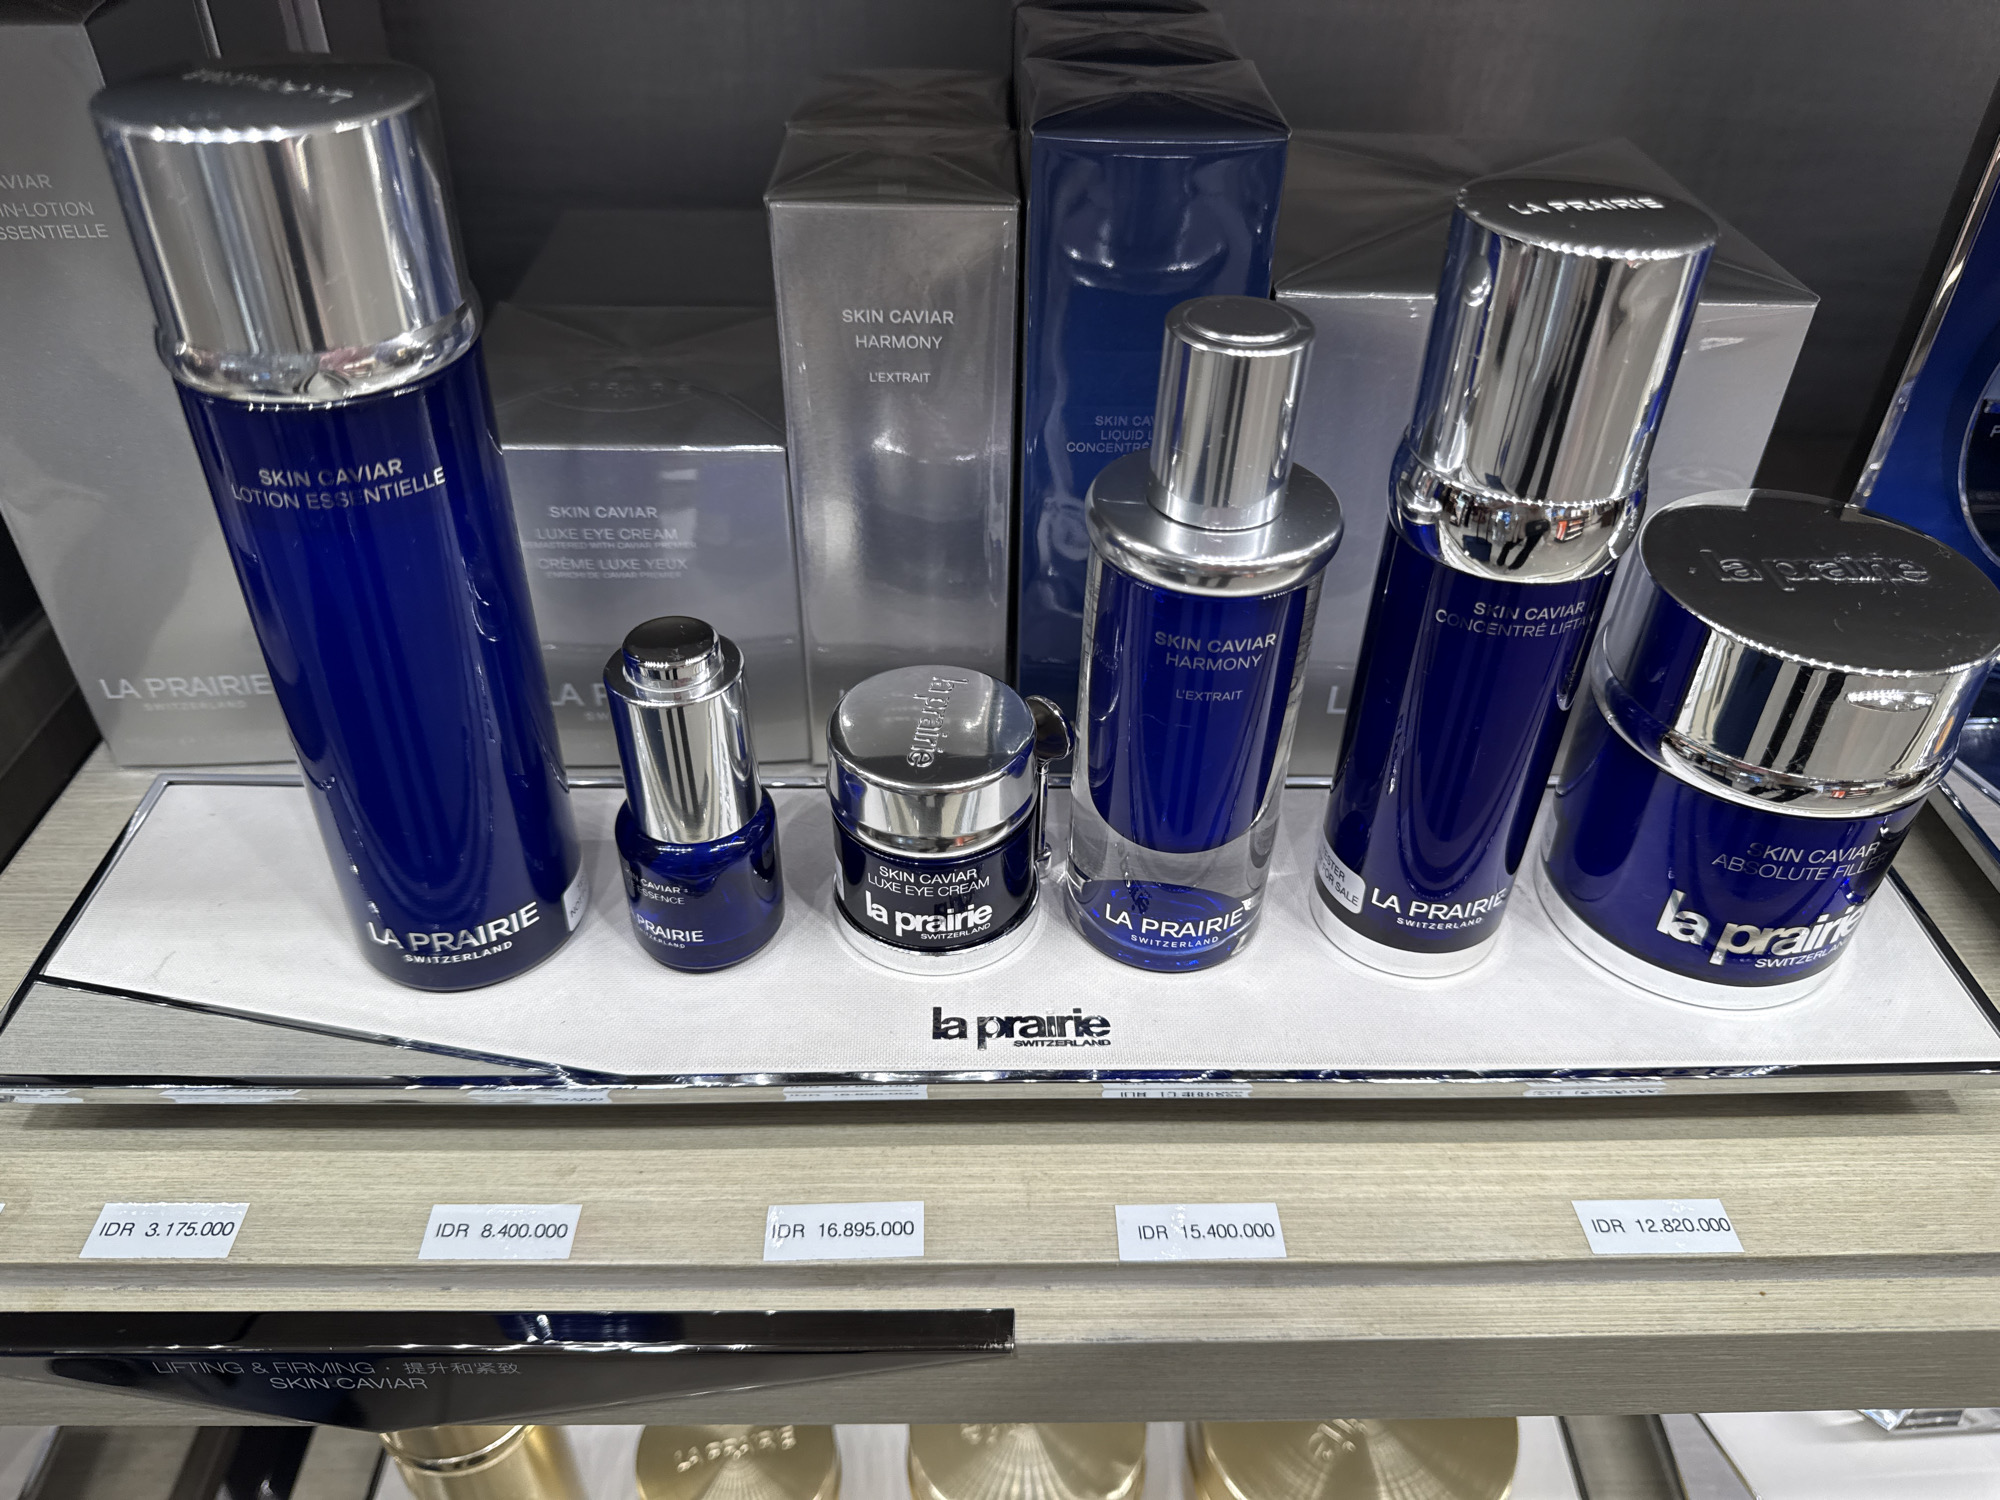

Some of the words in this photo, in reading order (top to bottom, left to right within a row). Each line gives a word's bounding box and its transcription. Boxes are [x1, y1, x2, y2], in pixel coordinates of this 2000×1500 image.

[1508, 202, 1550, 215] LA
[1547, 198, 1665, 212] PRAIRIE
[842, 309, 884, 324] SKIN
[889, 309, 955, 325] CAVIAR
[855, 335, 943, 349] HARMONY
[869, 372, 931, 383] L'EXTRAIT
[1095, 415, 1128, 426] SKIN
[1100, 430, 1144, 442] LIQUID
[258, 468, 311, 488] SKIN
[318, 458, 404, 487] CAVIAR
[230, 483, 300, 510] LOTION
[307, 466, 446, 510] ESSENTIELLE
[549, 506, 590, 518] SKIN
[595, 506, 659, 519] CAVIAR
[537, 528, 579, 540] LUXE
[584, 528, 615, 540] EYE
[619, 528, 679, 540] CREAM
[600, 558, 641, 571] LUXE
[644, 558, 688, 571] YEUX
[1700, 548, 1763, 583] la
[1761, 551, 1931, 592] prairie
[1473, 602, 1520, 620] SKIN
[1524, 601, 1586, 621] CAVIAR
[1435, 608, 1547, 637] CONCENTRÉ
[1154, 631, 1200, 652] SKIN
[1207, 633, 1277, 654] CAVIAR
[1165, 652, 1263, 671] HARMONY
[99, 678, 142, 699] LA
[144, 673, 275, 699] PRAIRIE
[1176, 688, 1244, 702] L'EXTRAIT
[1747, 842, 1804, 863] SKIN
[1808, 841, 1880, 864] CAVIAR
[879, 865, 915, 883] SKIN
[919, 868, 978, 885] CAVIAR
[1712, 853, 1829, 882] ABSOLUTE
[640, 878, 681, 893] CAVIAR
[867, 872, 901, 894] LUXE
[905, 885, 934, 897] EYE
[938, 876, 990, 897] CREAM
[1335, 881, 1359, 907] SALE
[865, 890, 888, 925] la
[894, 904, 993, 937] prairie
[1371, 888, 1401, 914] LA
[1409, 888, 1507, 921] PRAIRIE
[368, 921, 405, 950] LA
[408, 901, 541, 952] PRAIRIE
[637, 913, 705, 943] PRAIRIE
[1105, 903, 1133, 930] LA
[1141, 906, 1245, 938] PRAIRIE
[1396, 917, 1484, 930] SWITZERLAND
[1656, 888, 1711, 945] la
[1709, 905, 1866, 966] prairie
[920, 922, 991, 940] SWITZERLAND
[1131, 934, 1219, 948] SWITZERLAND
[404, 940, 513, 963] SWITZERLAND
[932, 1007, 967, 1040] la
[977, 1008, 1111, 1050] prairie
[1014, 1039, 1111, 1047] SWITZERLAND
[99, 1222, 136, 1237] IDR
[144, 1221, 235, 1237] 3.175.000
[435, 1223, 470, 1238] IDR
[481, 1223, 569, 1239] 8.400.000
[772, 1223, 806, 1239] IDR
[818, 1220, 915, 1238] 16.895.000
[1138, 1225, 1168, 1240] IDR
[1181, 1222, 1275, 1239] 15.400.000
[1591, 1218, 1626, 1234] IDR
[1635, 1217, 1731, 1233] 12.820.000
[152, 1361, 245, 1375] LIFTING
[252, 1361, 269, 1375] &
[272, 1361, 376, 1375] FIRMING
[270, 1377, 330, 1390] SKIN
[336, 1377, 429, 1390] CAVIAR
